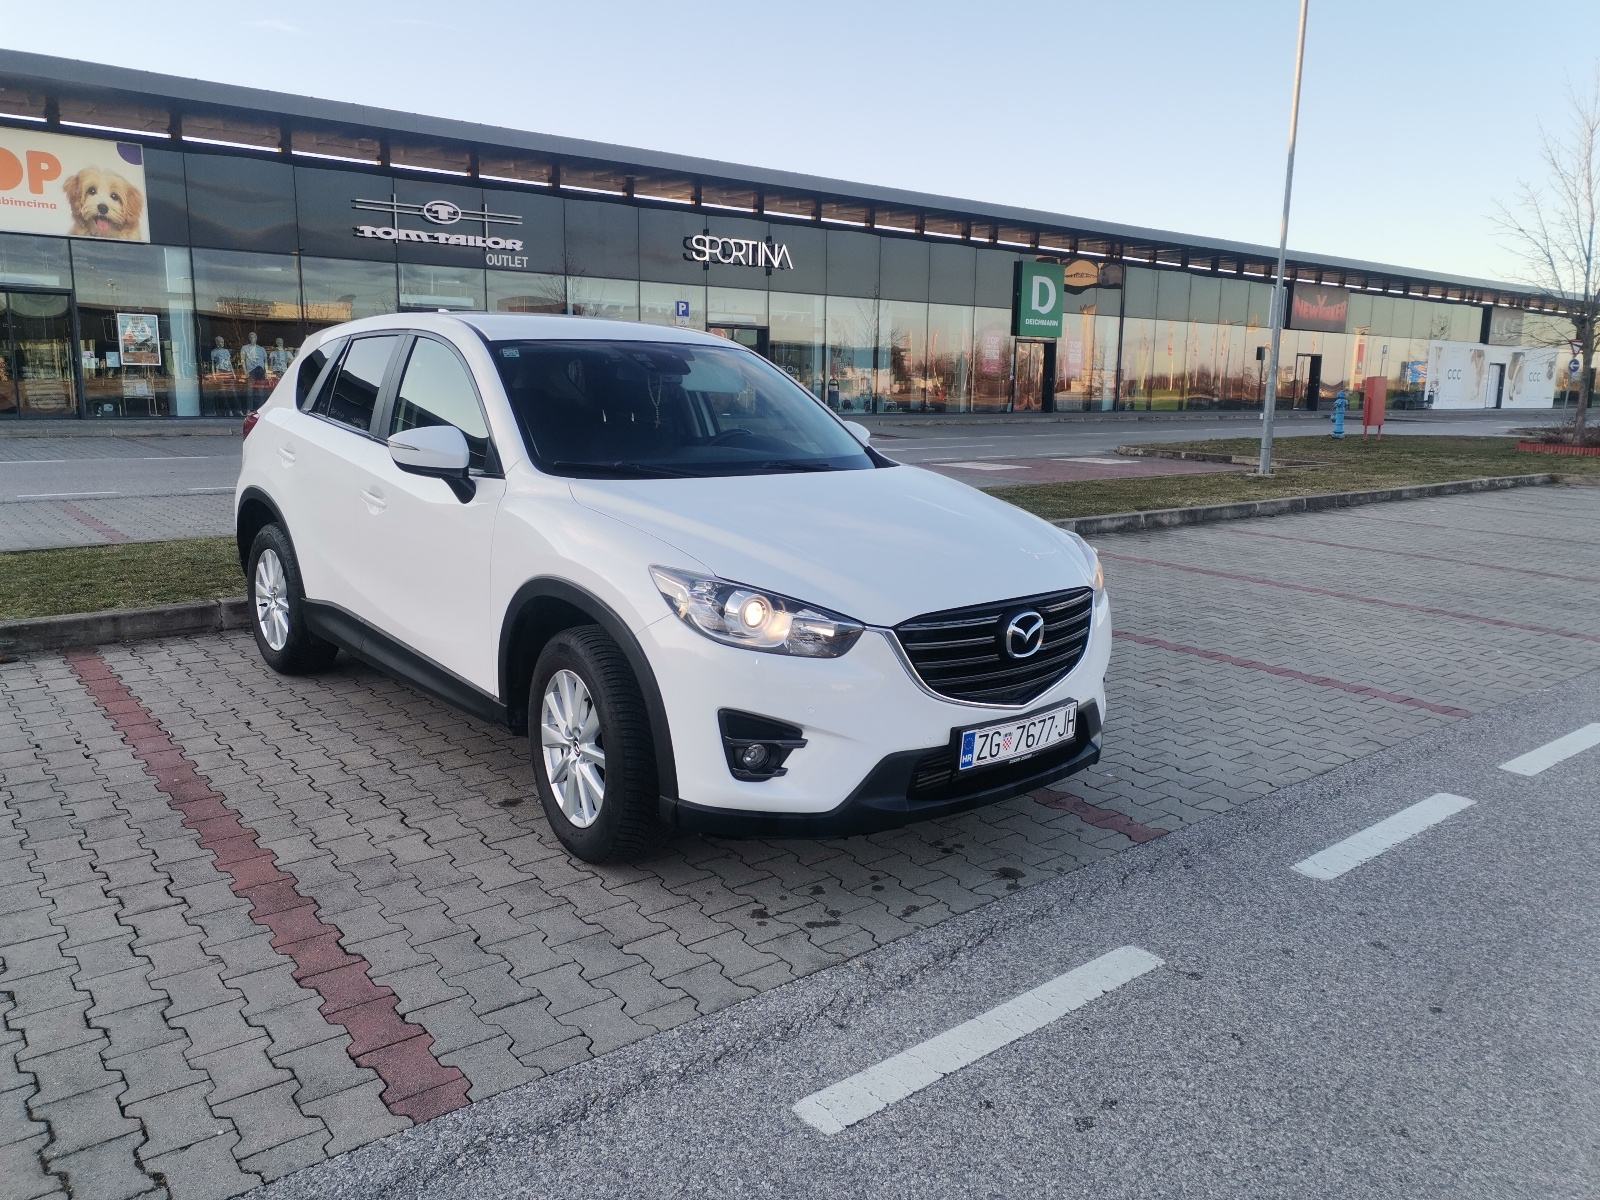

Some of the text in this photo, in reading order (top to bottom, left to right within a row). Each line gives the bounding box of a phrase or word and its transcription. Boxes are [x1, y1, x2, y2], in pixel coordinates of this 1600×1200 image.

[0, 196, 57, 210] bimcima
[691, 234, 794, 269] SPORTINA
[486, 253, 528, 268] OUTLET
[1031, 275, 1057, 314] D
[1025, 318, 1058, 327] DEICHMANN
[1447, 369, 1461, 380] CCC
[1528, 371, 1541, 383] CCC
[976, 731, 1002, 761] ZG
[962, 753, 972, 764] HR
